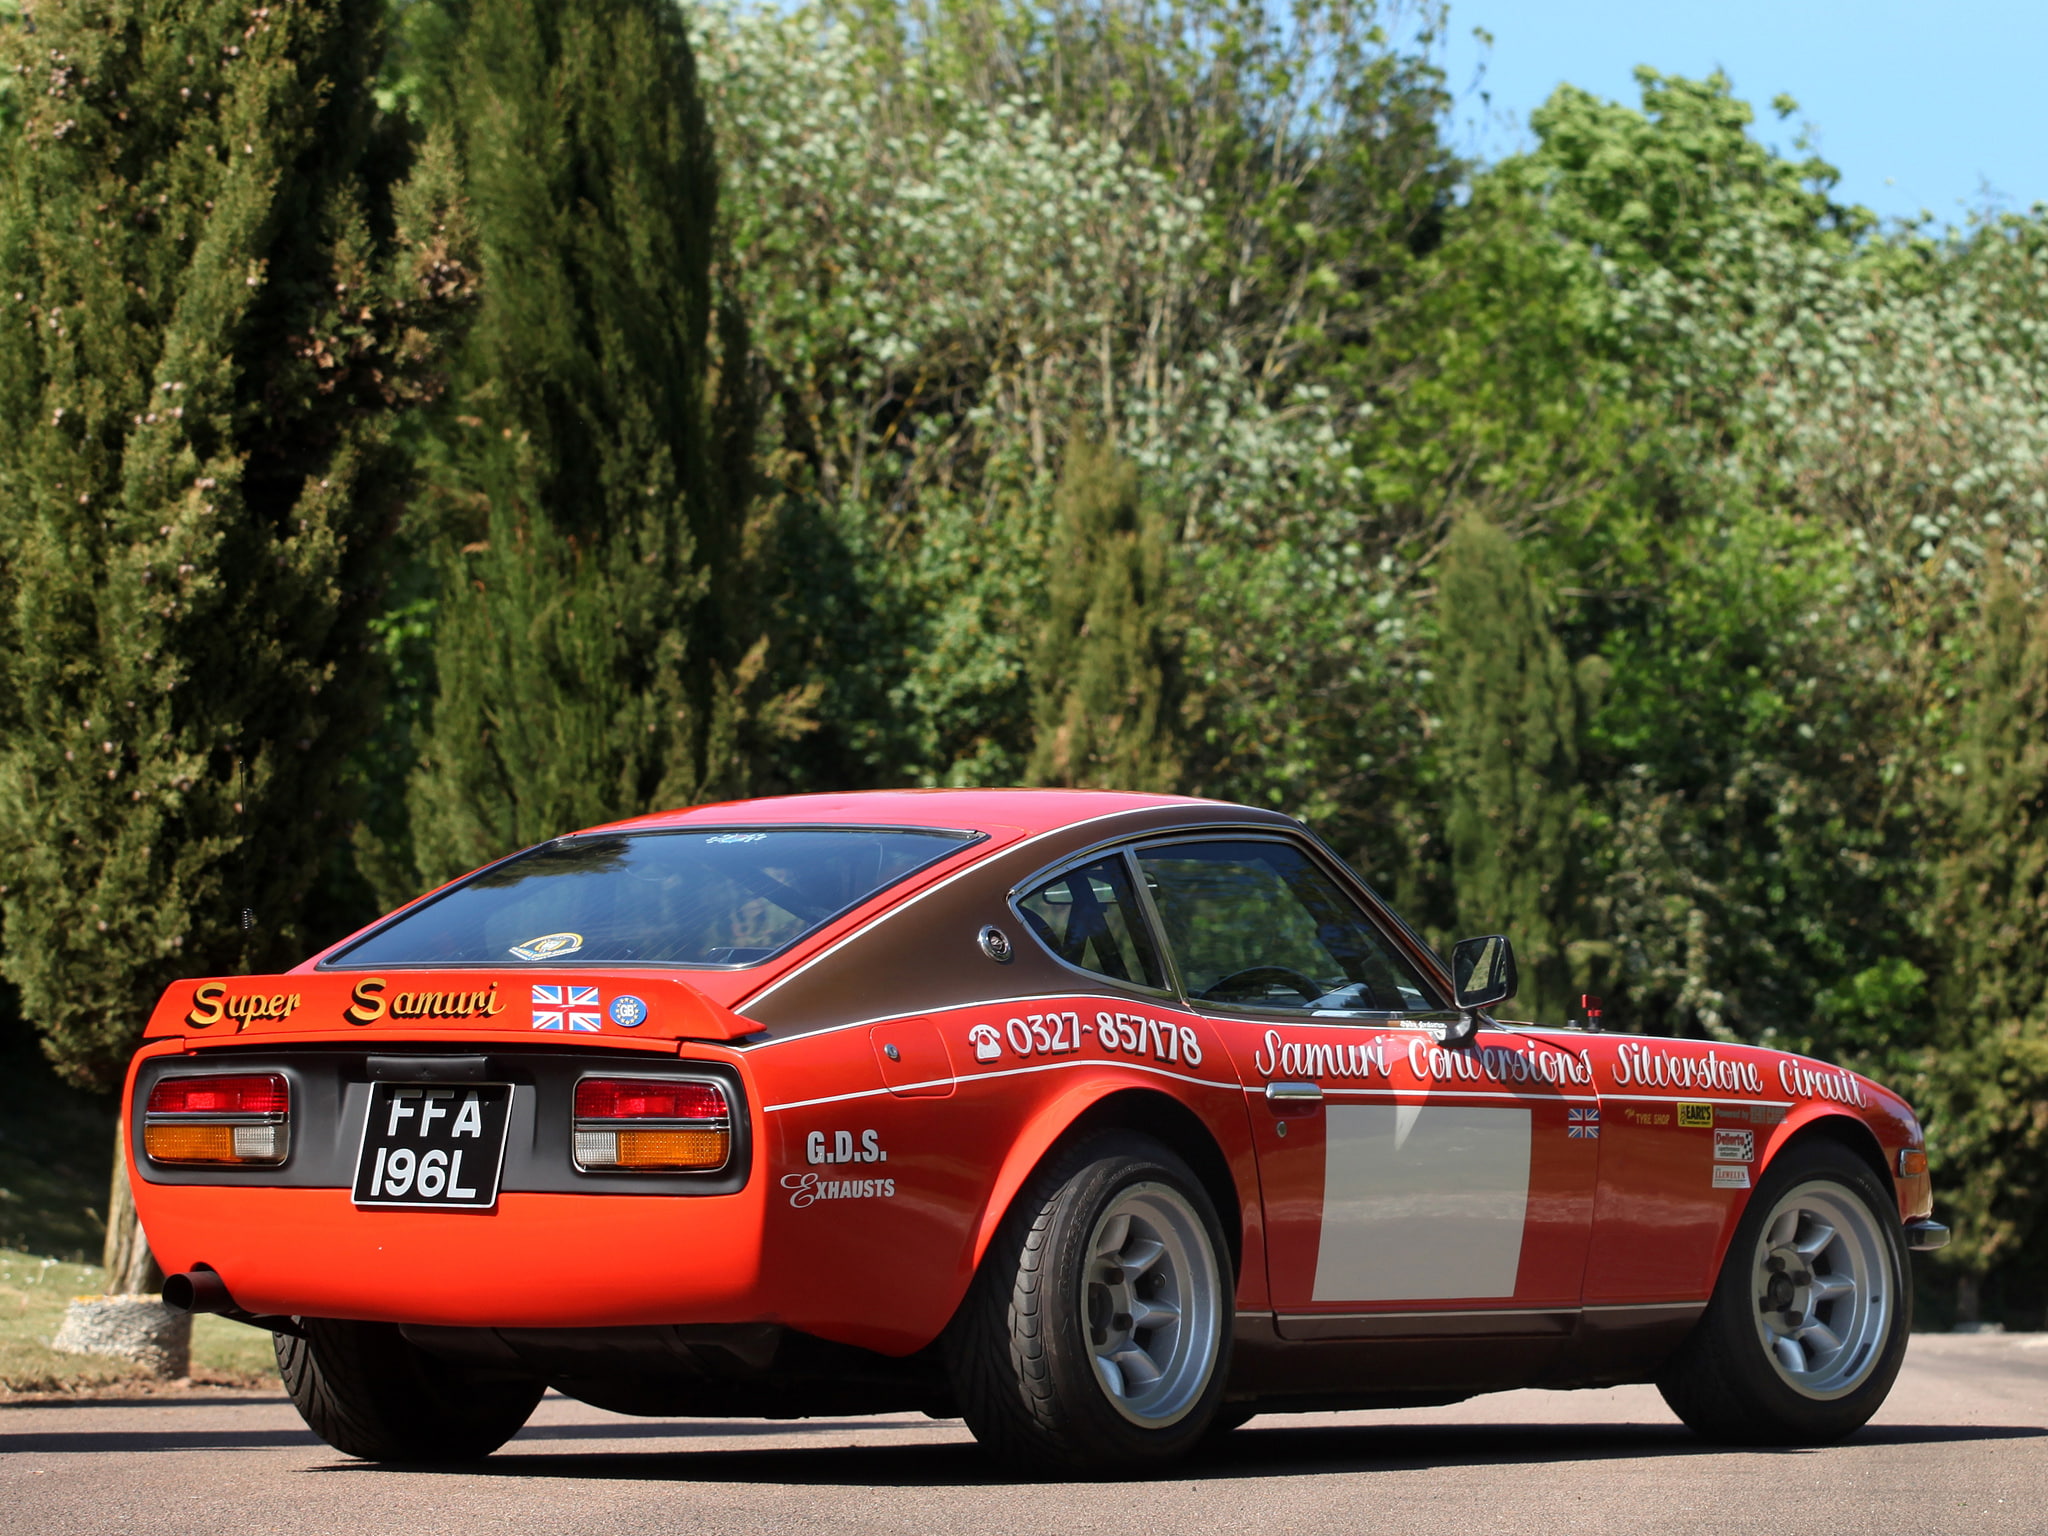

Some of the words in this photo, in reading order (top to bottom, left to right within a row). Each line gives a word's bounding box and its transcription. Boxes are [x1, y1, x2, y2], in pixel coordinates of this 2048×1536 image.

[188, 982, 301, 1033] Super
[345, 977, 507, 1026] Samuri
[620, 1004, 635, 1017] GB
[1255, 1029, 1393, 1078] Samuri
[1408, 1037, 1594, 1085] Conversions
[1612, 1042, 1764, 1094] Silverstone
[1778, 1058, 1868, 1110] Circuit
[387, 1089, 483, 1138] FFA
[1636, 1113, 1653, 1125] TYRE
[1653, 1113, 1671, 1126] SHOP
[1686, 1104, 1711, 1121] EARL'S
[806, 1129, 888, 1165] G.D.S.
[369, 1147, 477, 1200] 196L
